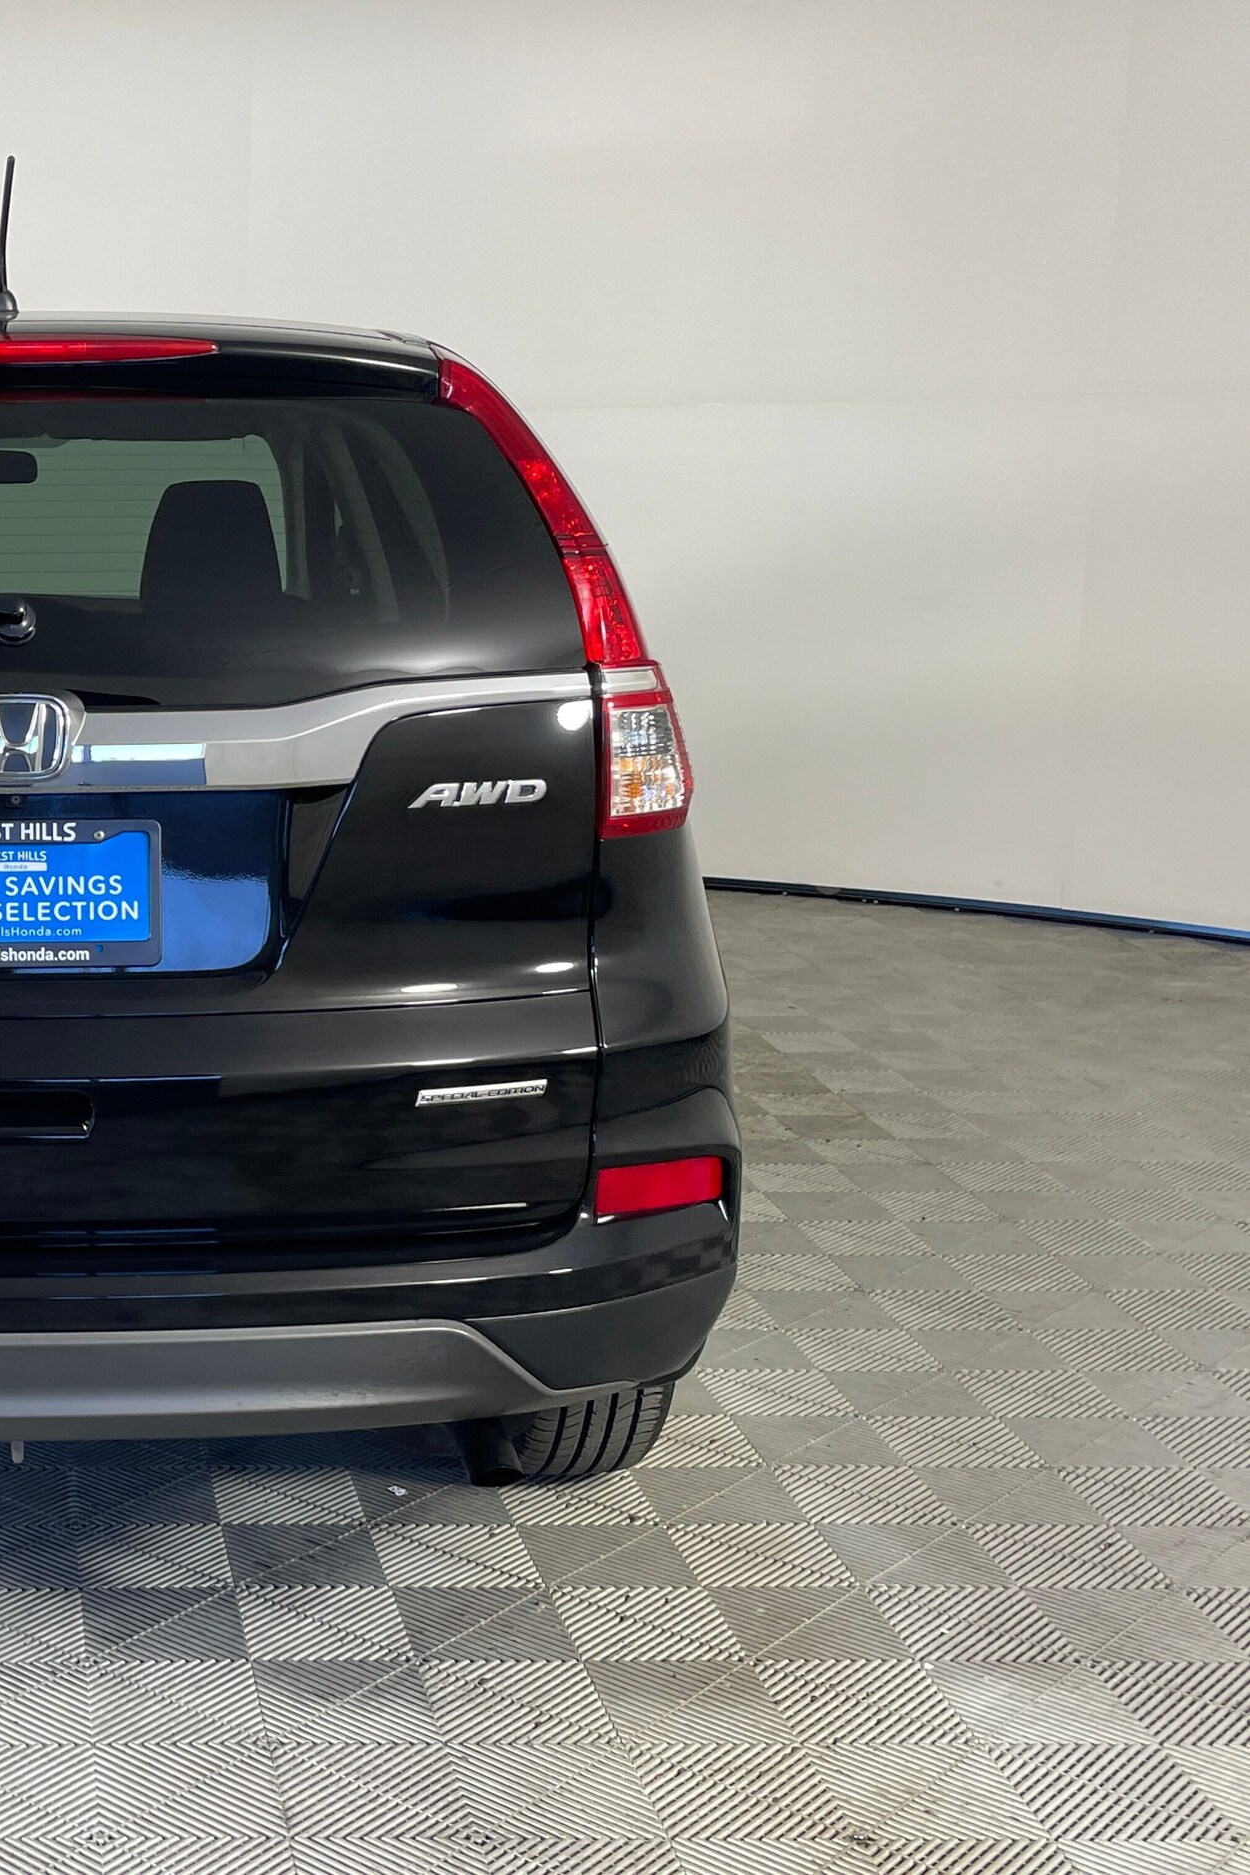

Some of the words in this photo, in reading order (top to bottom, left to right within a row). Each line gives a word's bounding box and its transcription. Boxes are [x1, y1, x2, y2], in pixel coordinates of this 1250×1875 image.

[406, 779, 547, 809] AWD
[20, 822, 77, 842] HILLS
[17, 850, 48, 861] HILLS
[5, 875, 123, 896] SAVINGS
[420, 1091, 482, 1102] SPECIAL
[487, 1084, 546, 1097] EDITION
